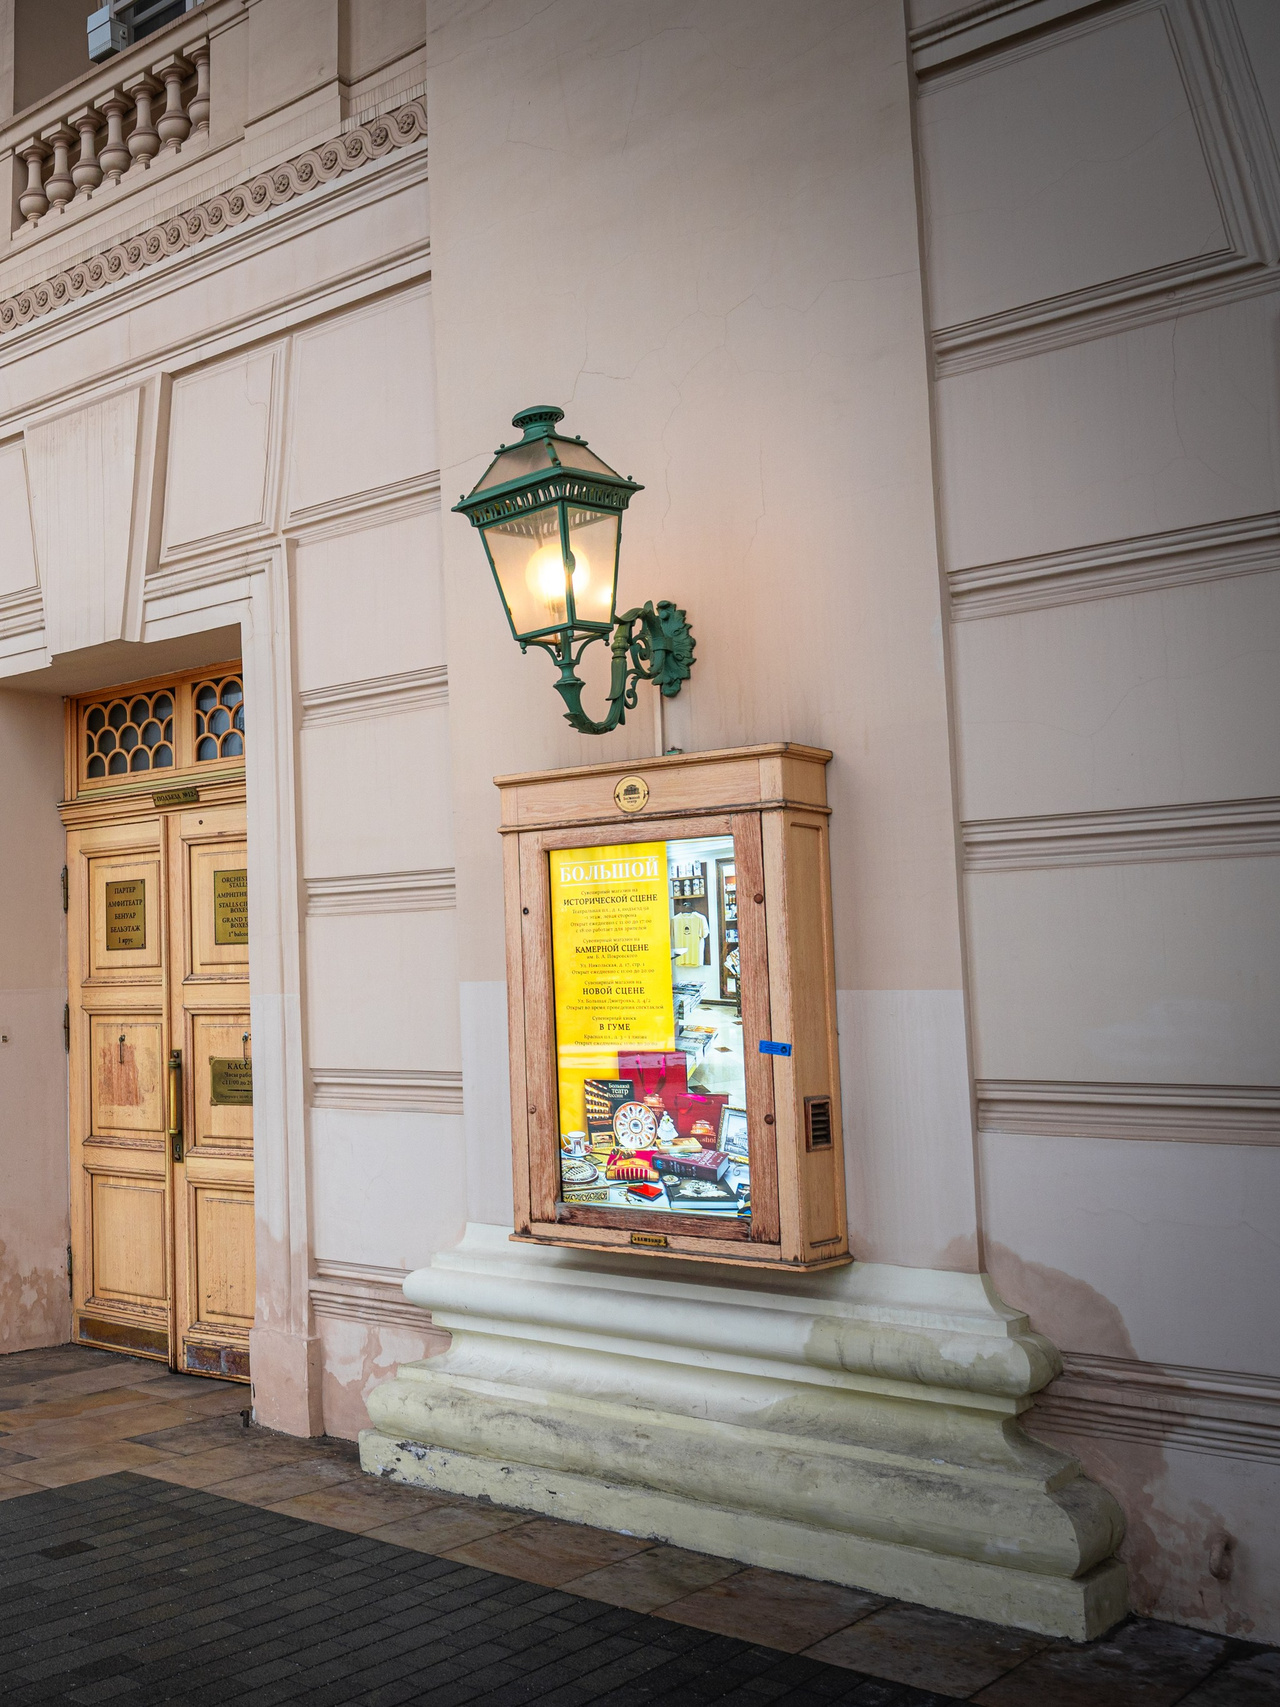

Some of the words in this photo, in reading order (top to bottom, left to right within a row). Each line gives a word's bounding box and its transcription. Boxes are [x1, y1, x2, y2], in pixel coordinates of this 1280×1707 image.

[560, 857, 659, 882] БОЛЬШОЙ
[108, 899, 143, 907] АМФИТЕАТР
[563, 894, 628, 906] ИСТОРИЧЕСКОЙ
[630, 894, 658, 903] СЦЕНЕ
[110, 925, 141, 933] БЕЛЬЭТАЖ
[575, 943, 619, 953] КАМЕРНОЙ
[621, 944, 650, 952] СЦЕНЕ
[582, 985, 613, 995] НОВОЙ
[615, 986, 645, 995] СЦЕНЕ
[599, 1023, 605, 1031] В
[607, 1023, 631, 1031] ГУМЕ
[611, 1088, 629, 1096] театр
